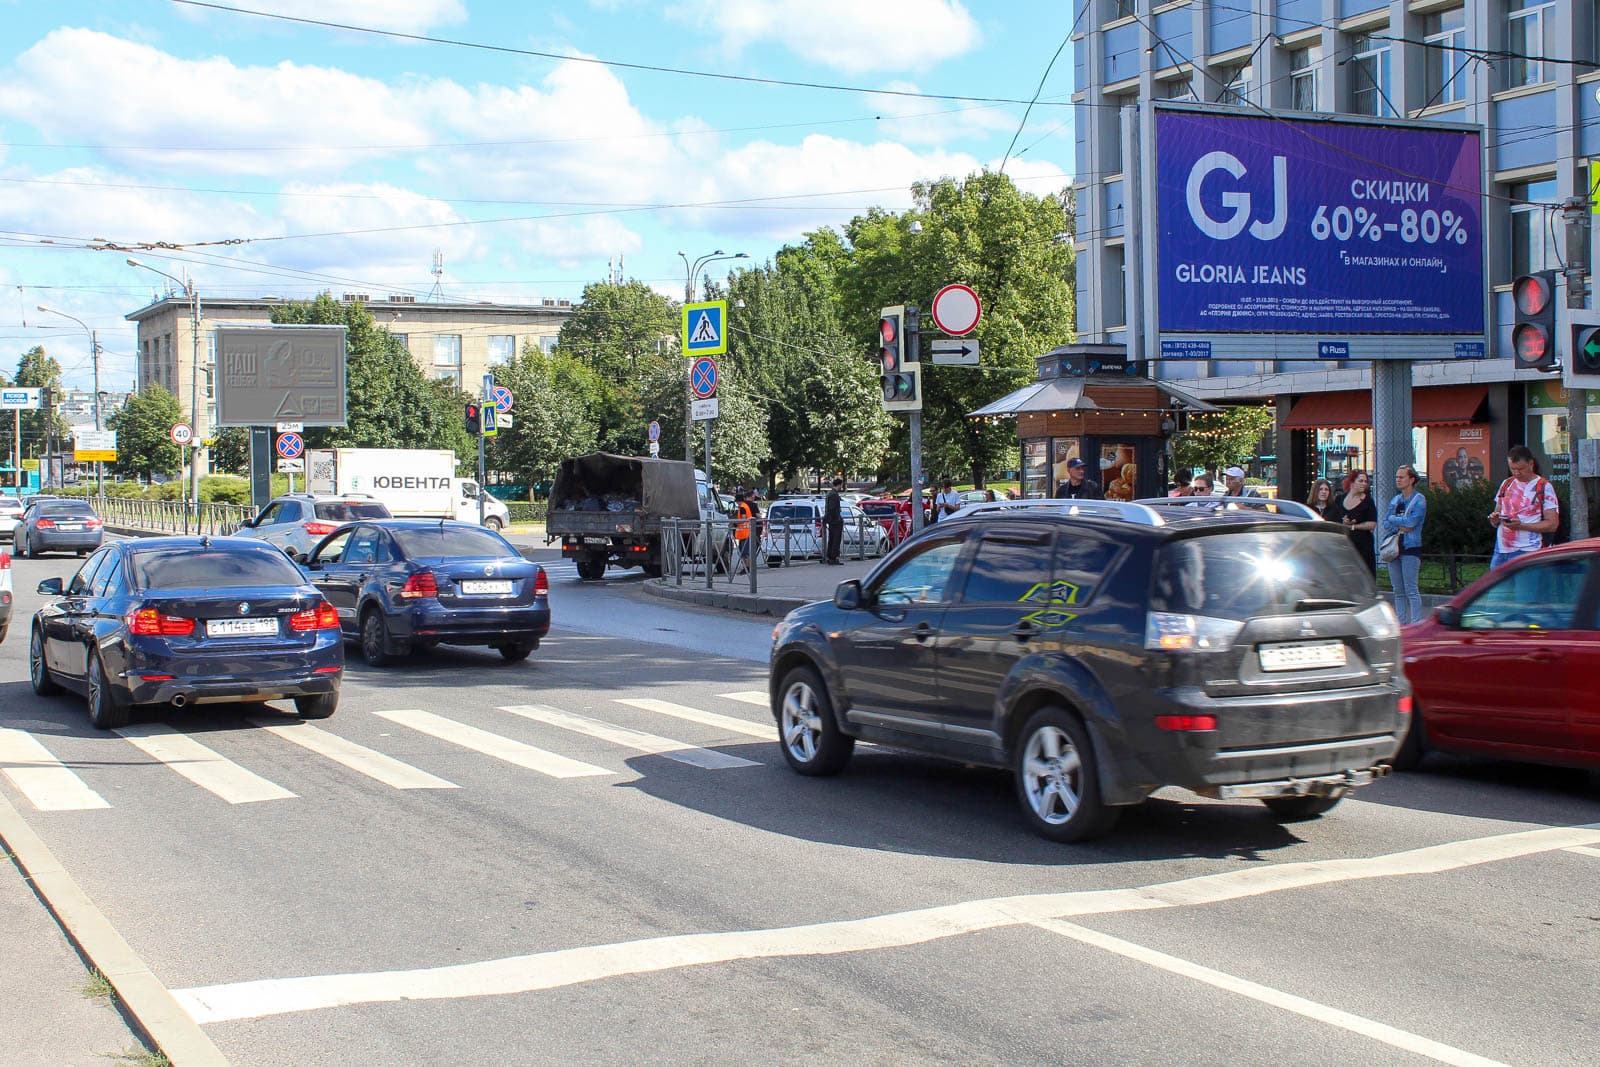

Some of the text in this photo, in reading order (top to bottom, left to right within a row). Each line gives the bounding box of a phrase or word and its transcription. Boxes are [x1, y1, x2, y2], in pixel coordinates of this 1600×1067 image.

[1186, 151, 1288, 241] GJ
[1351, 179, 1429, 204] СКИДКИ
[1311, 205, 1468, 245] 60%-80%
[1344, 256, 1443, 268] В МАГАЗИНАХ И ОНЛАЙН
[1176, 263, 1307, 287] GLORIA JEANS
[1329, 345, 1347, 354] Russ
[175, 429, 188, 438] 40
[373, 475, 450, 489] ЮВЕНТА
